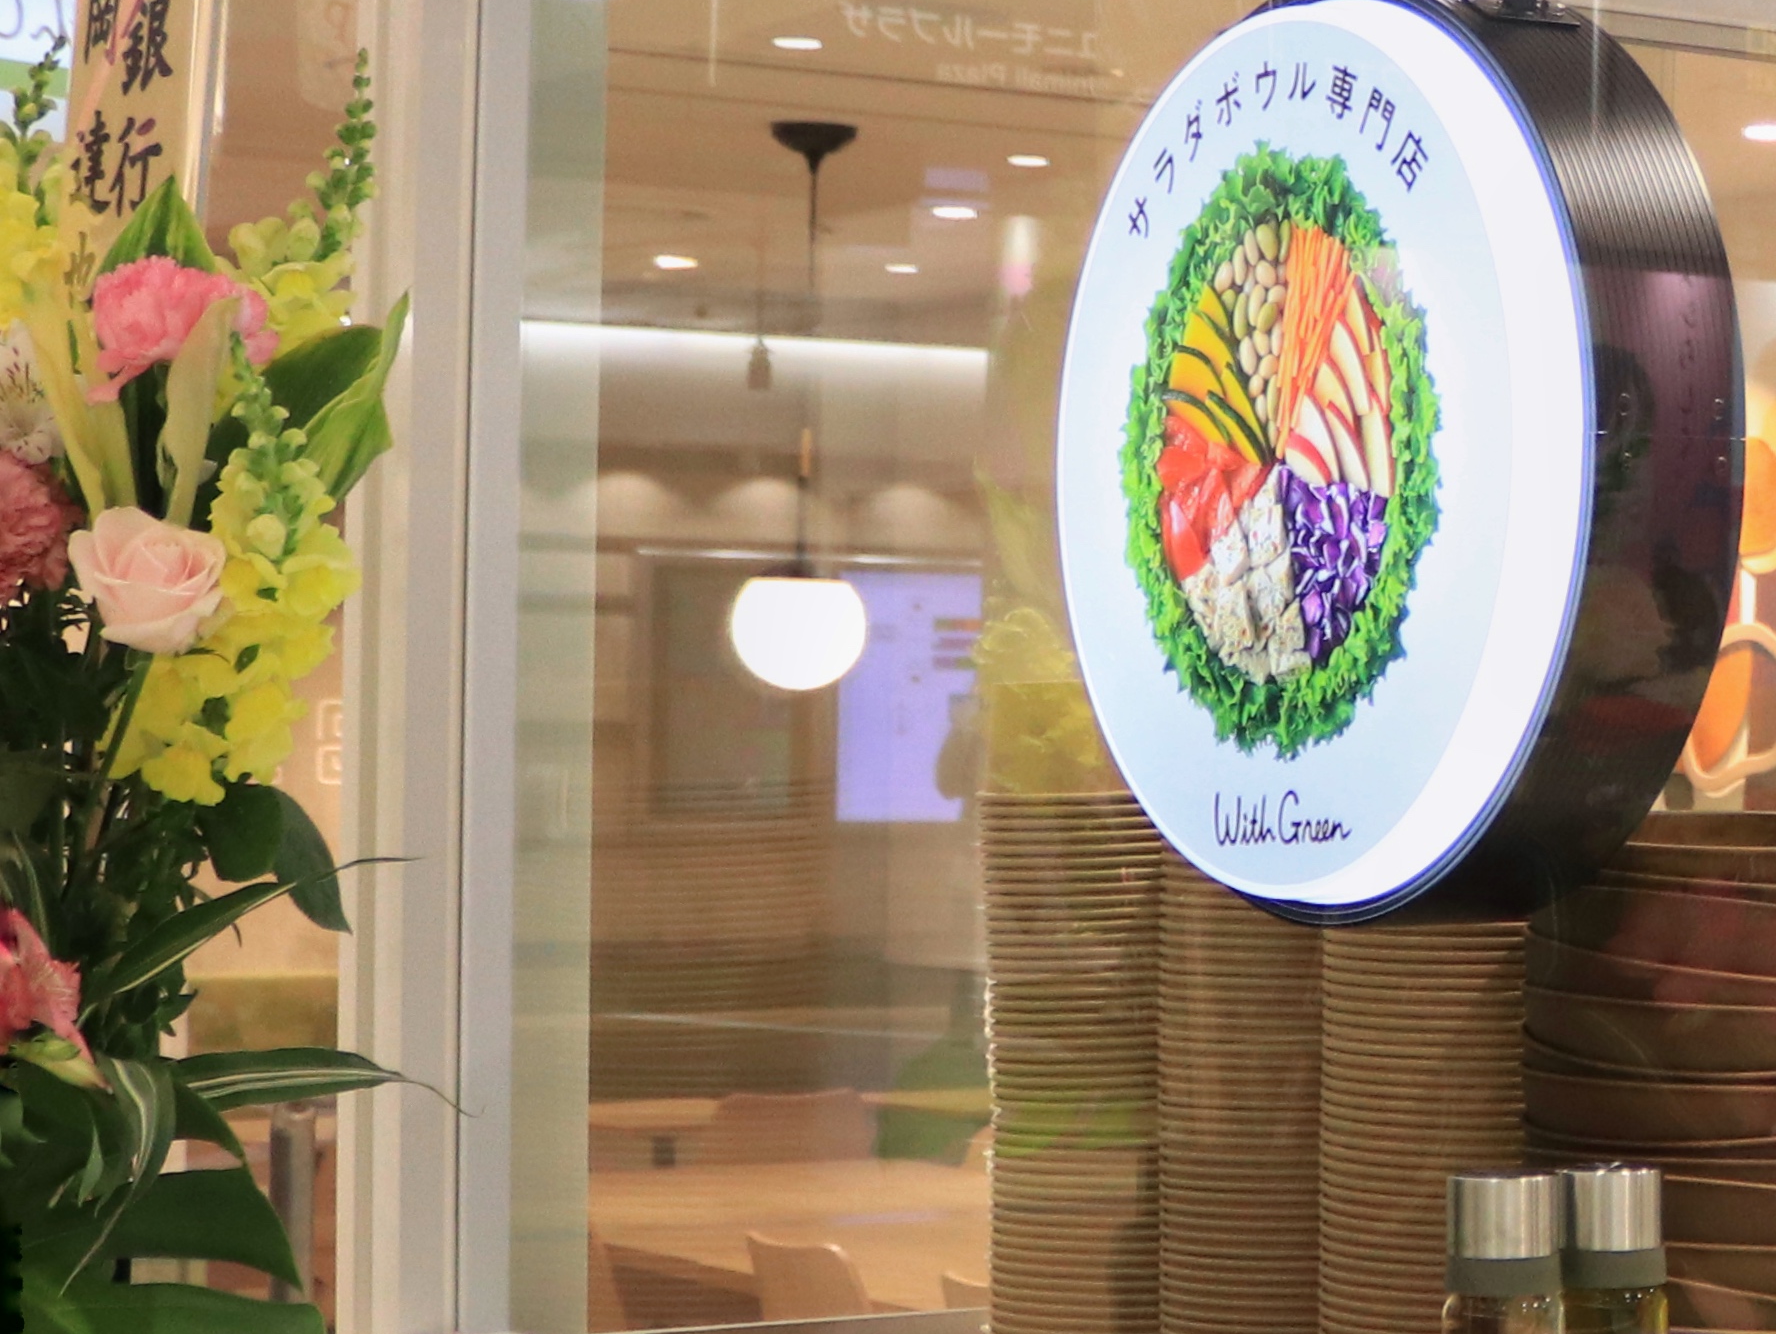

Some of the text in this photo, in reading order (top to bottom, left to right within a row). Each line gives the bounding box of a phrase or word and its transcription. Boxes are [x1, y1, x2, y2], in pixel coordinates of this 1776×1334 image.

[1128, 61, 1430, 239] サラダボウル専門店
[1214, 789, 1353, 847] With Green
